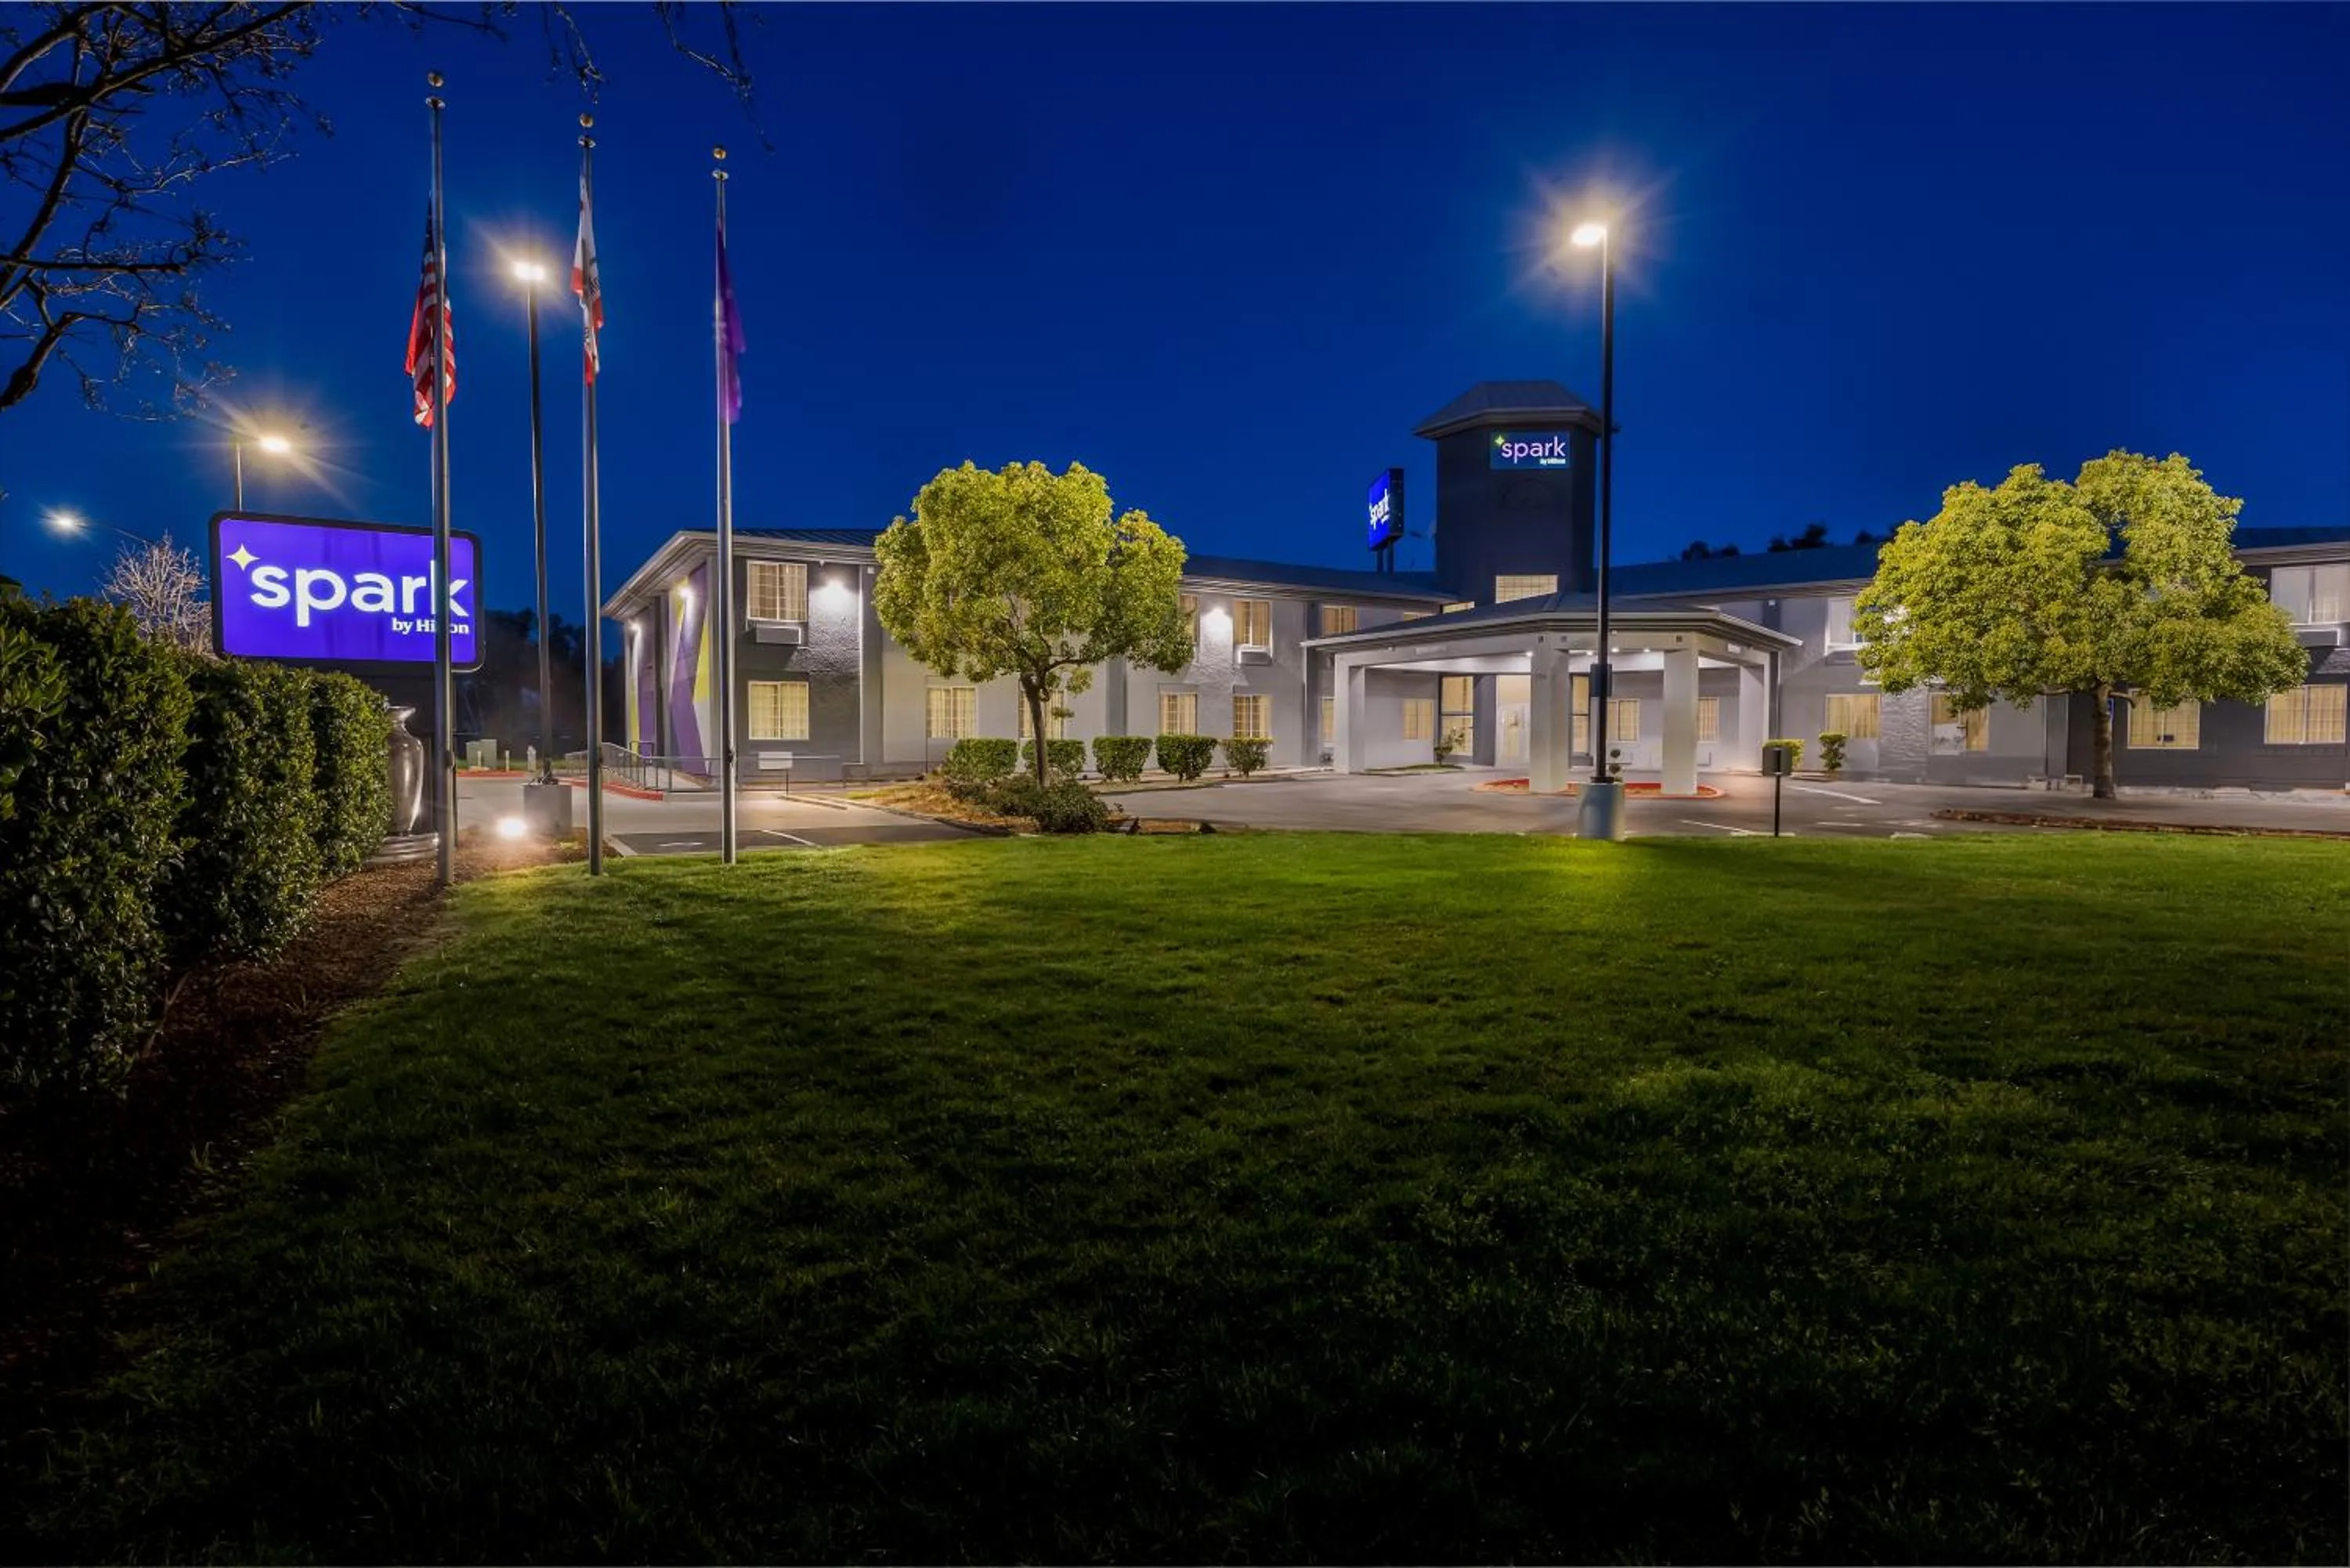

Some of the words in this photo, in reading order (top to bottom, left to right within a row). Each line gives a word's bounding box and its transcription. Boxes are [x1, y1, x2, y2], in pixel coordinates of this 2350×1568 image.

[1502, 435, 1566, 464] spark
[392, 617, 413, 635] by
[416, 619, 469, 634] Hion
